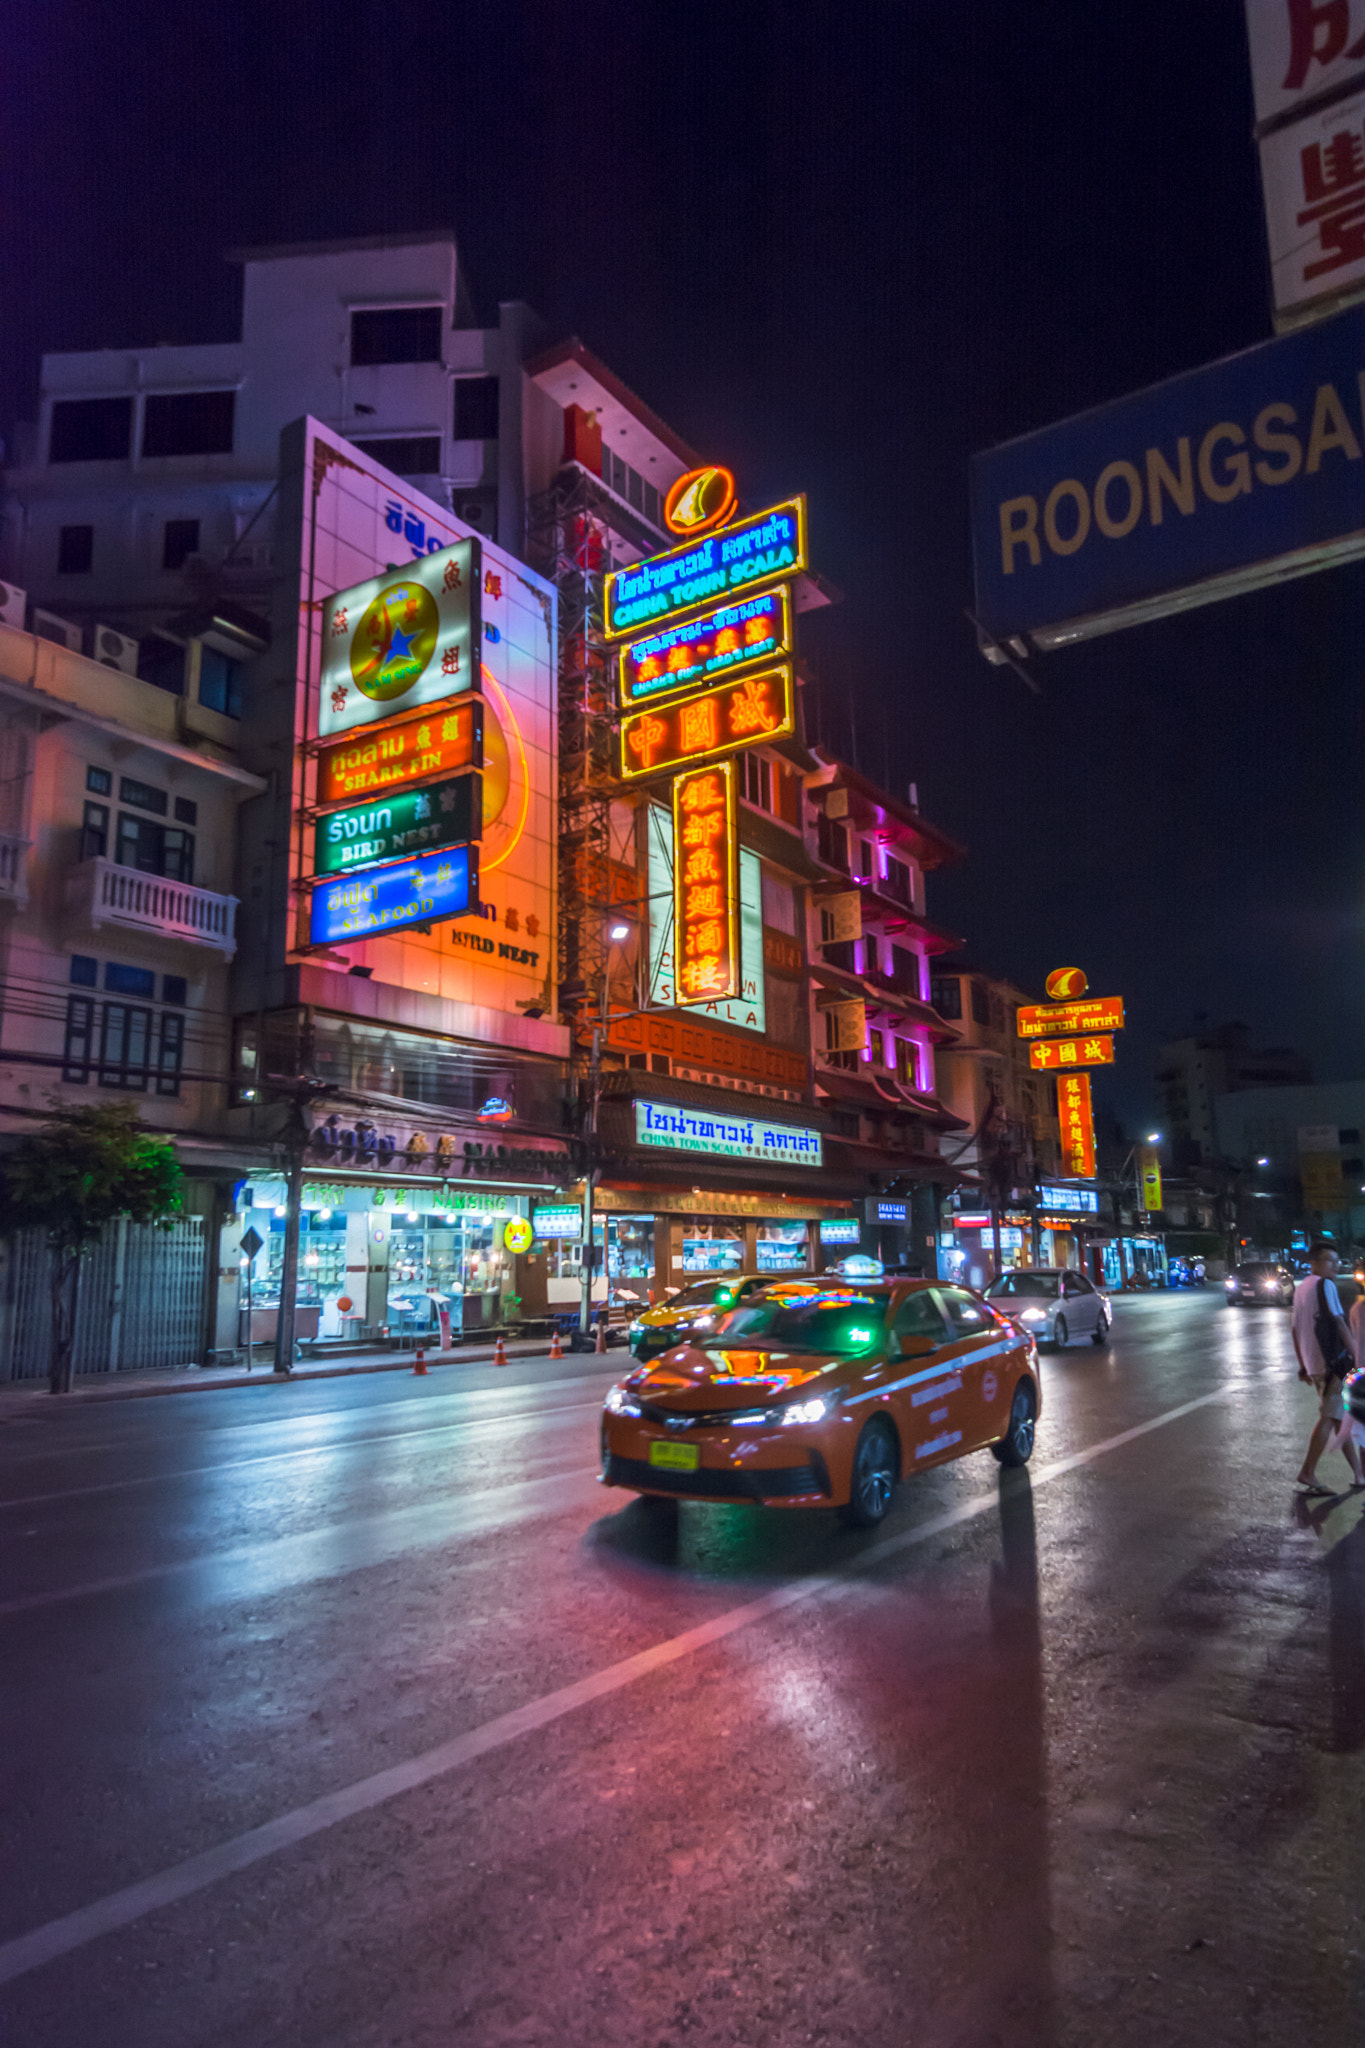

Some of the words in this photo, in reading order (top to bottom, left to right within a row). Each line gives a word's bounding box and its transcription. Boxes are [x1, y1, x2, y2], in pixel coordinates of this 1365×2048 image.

[1000, 370, 1365, 576] ROONGSA
[613, 593, 669, 626] CHINA
[670, 569, 727, 605] TOWN
[729, 545, 794, 584] SCALA
[628, 680, 774, 768] 中國城
[344, 763, 404, 792] SHARK
[410, 751, 442, 774] FIN
[327, 808, 392, 843] รังนก
[341, 839, 387, 863] BIRD
[392, 823, 442, 849] NEST
[342, 897, 434, 933] SEAFOOD
[498, 942, 540, 967] NEST
[661, 984, 758, 1027] SALA
[1034, 1040, 1106, 1066] 中國城
[641, 1132, 676, 1148] CHINA
[679, 1137, 708, 1152] TOWN
[711, 1142, 743, 1156] SCALA
[642, 1103, 754, 1144] ไชน่าทาวน์
[764, 1130, 819, 1153] สกาล่า
[432, 1195, 506, 1212] NAMSING
